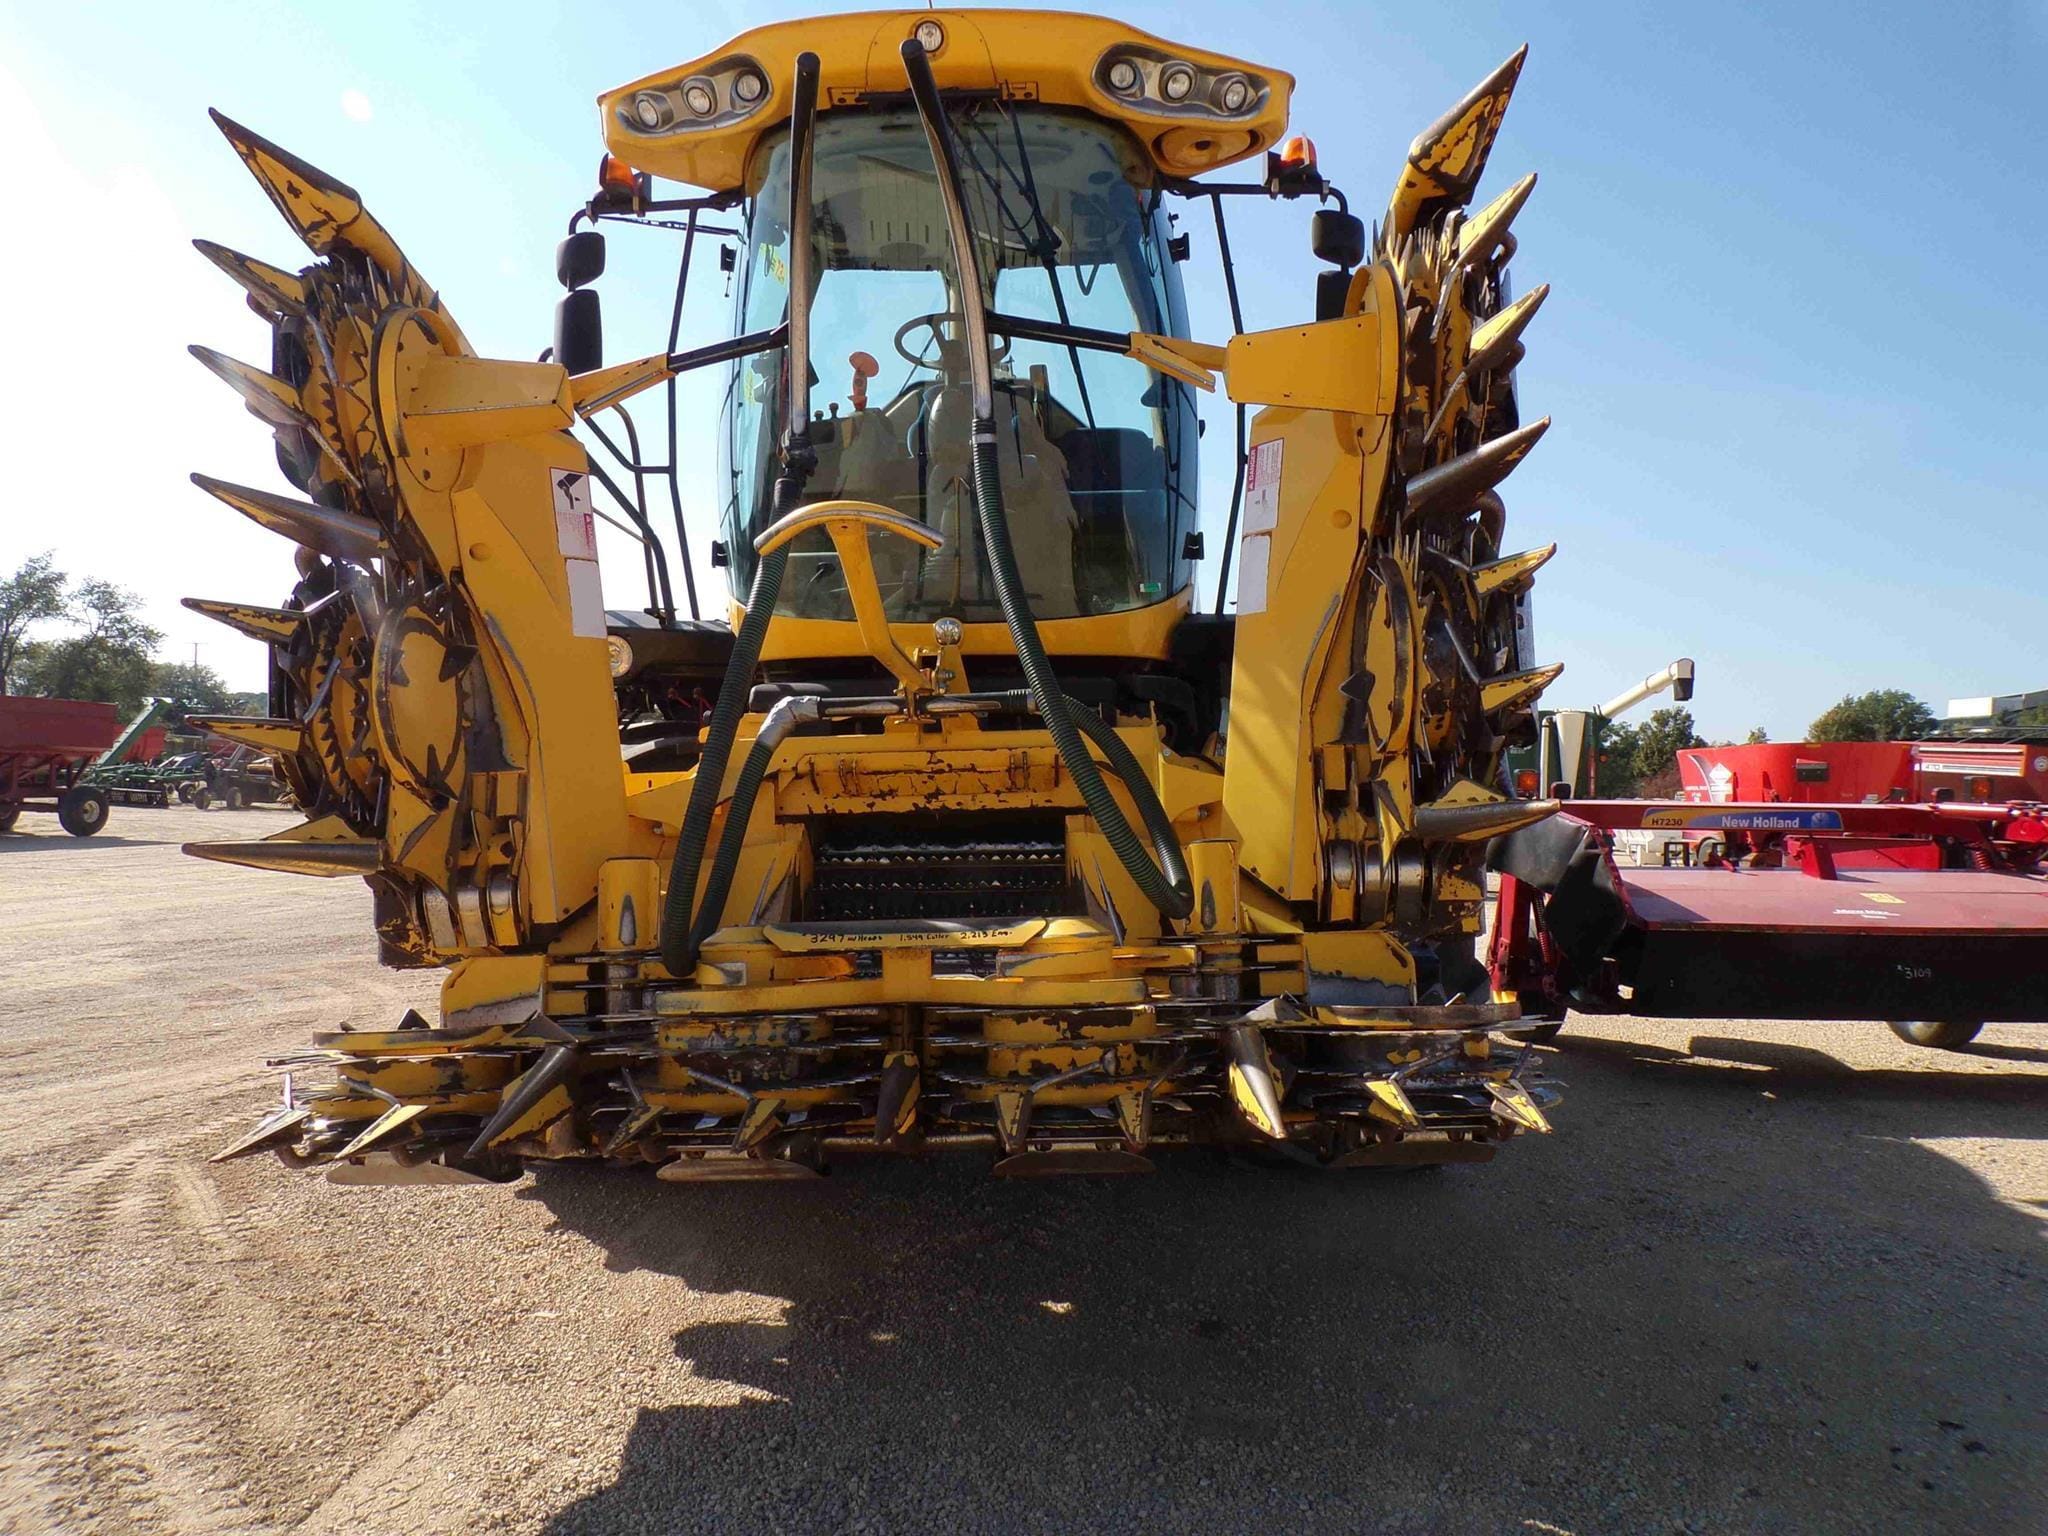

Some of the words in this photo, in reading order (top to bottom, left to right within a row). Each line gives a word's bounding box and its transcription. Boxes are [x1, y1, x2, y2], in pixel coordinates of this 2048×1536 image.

[1249, 448, 1257, 481] DANGER
[1651, 818, 1683, 827] H7230
[1721, 816, 1750, 828] New
[1753, 817, 1800, 829] Holland
